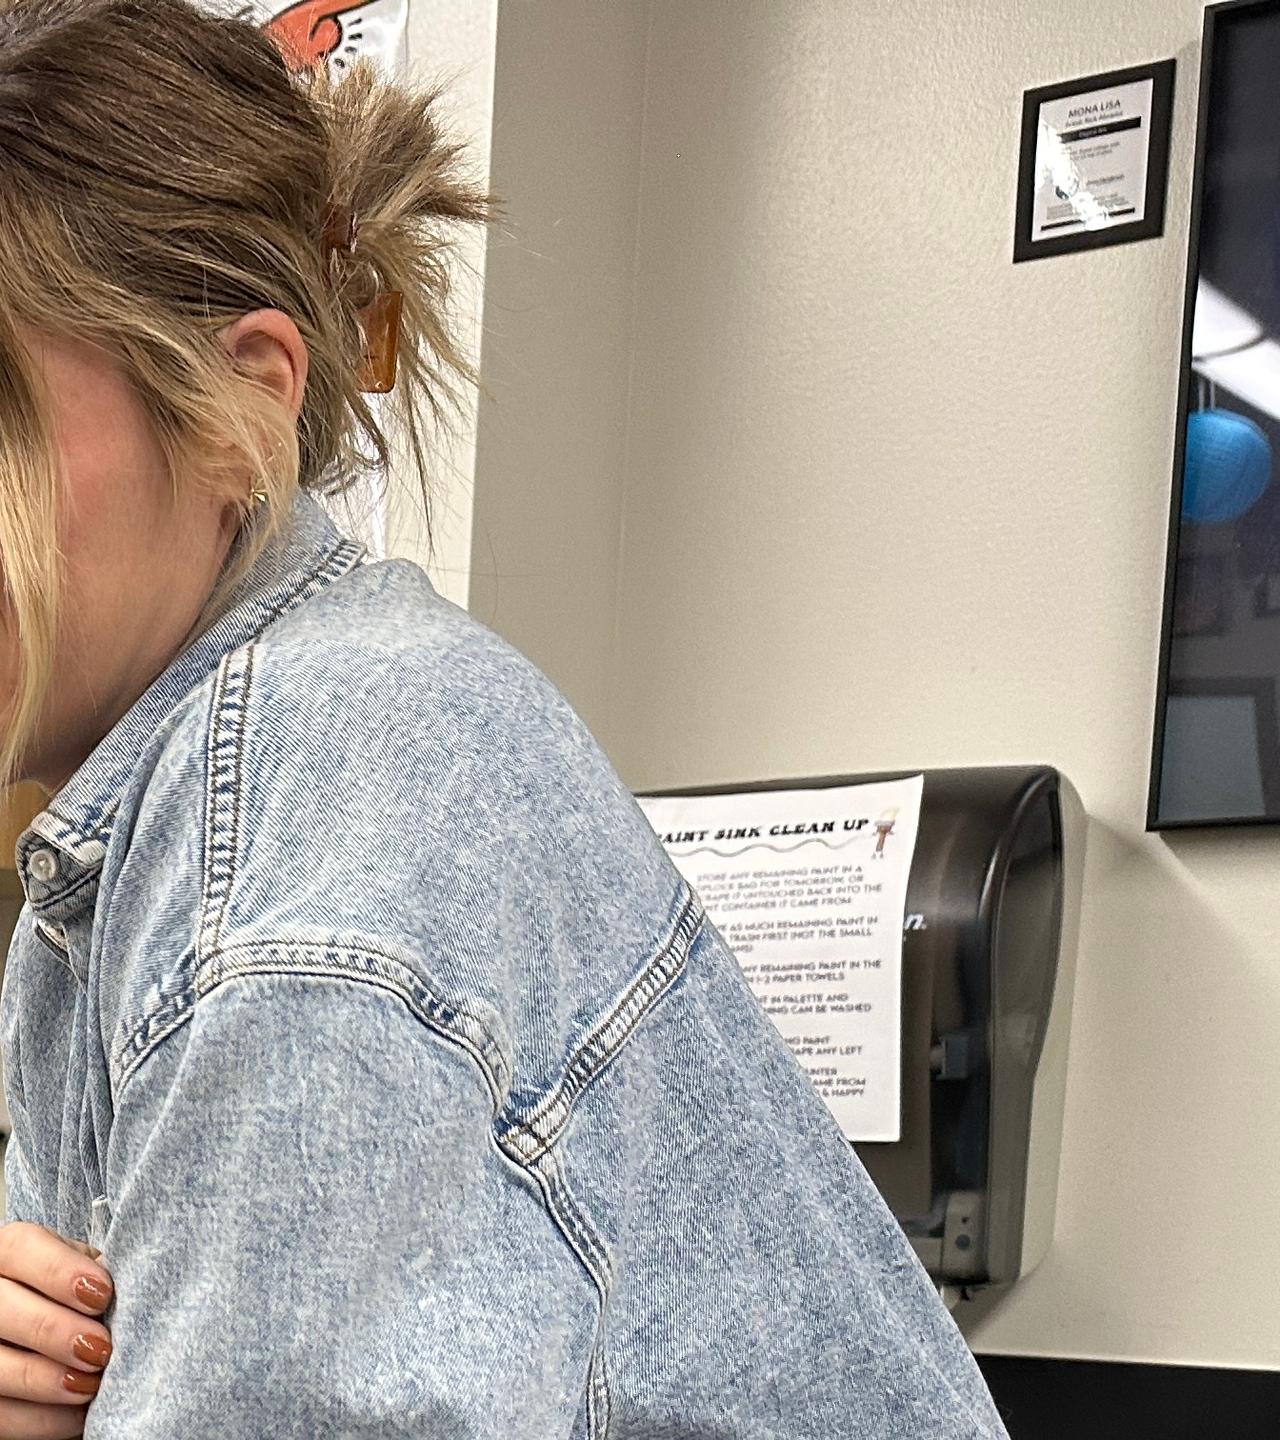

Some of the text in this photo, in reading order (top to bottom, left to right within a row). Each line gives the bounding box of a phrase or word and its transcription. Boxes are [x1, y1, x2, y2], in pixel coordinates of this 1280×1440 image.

[1068, 104, 1099, 118] MONA
[1100, 99, 1121, 111] LISA
[714, 825, 761, 840] SINK
[769, 820, 835, 837] CLEAN
[843, 818, 869, 831] UP
